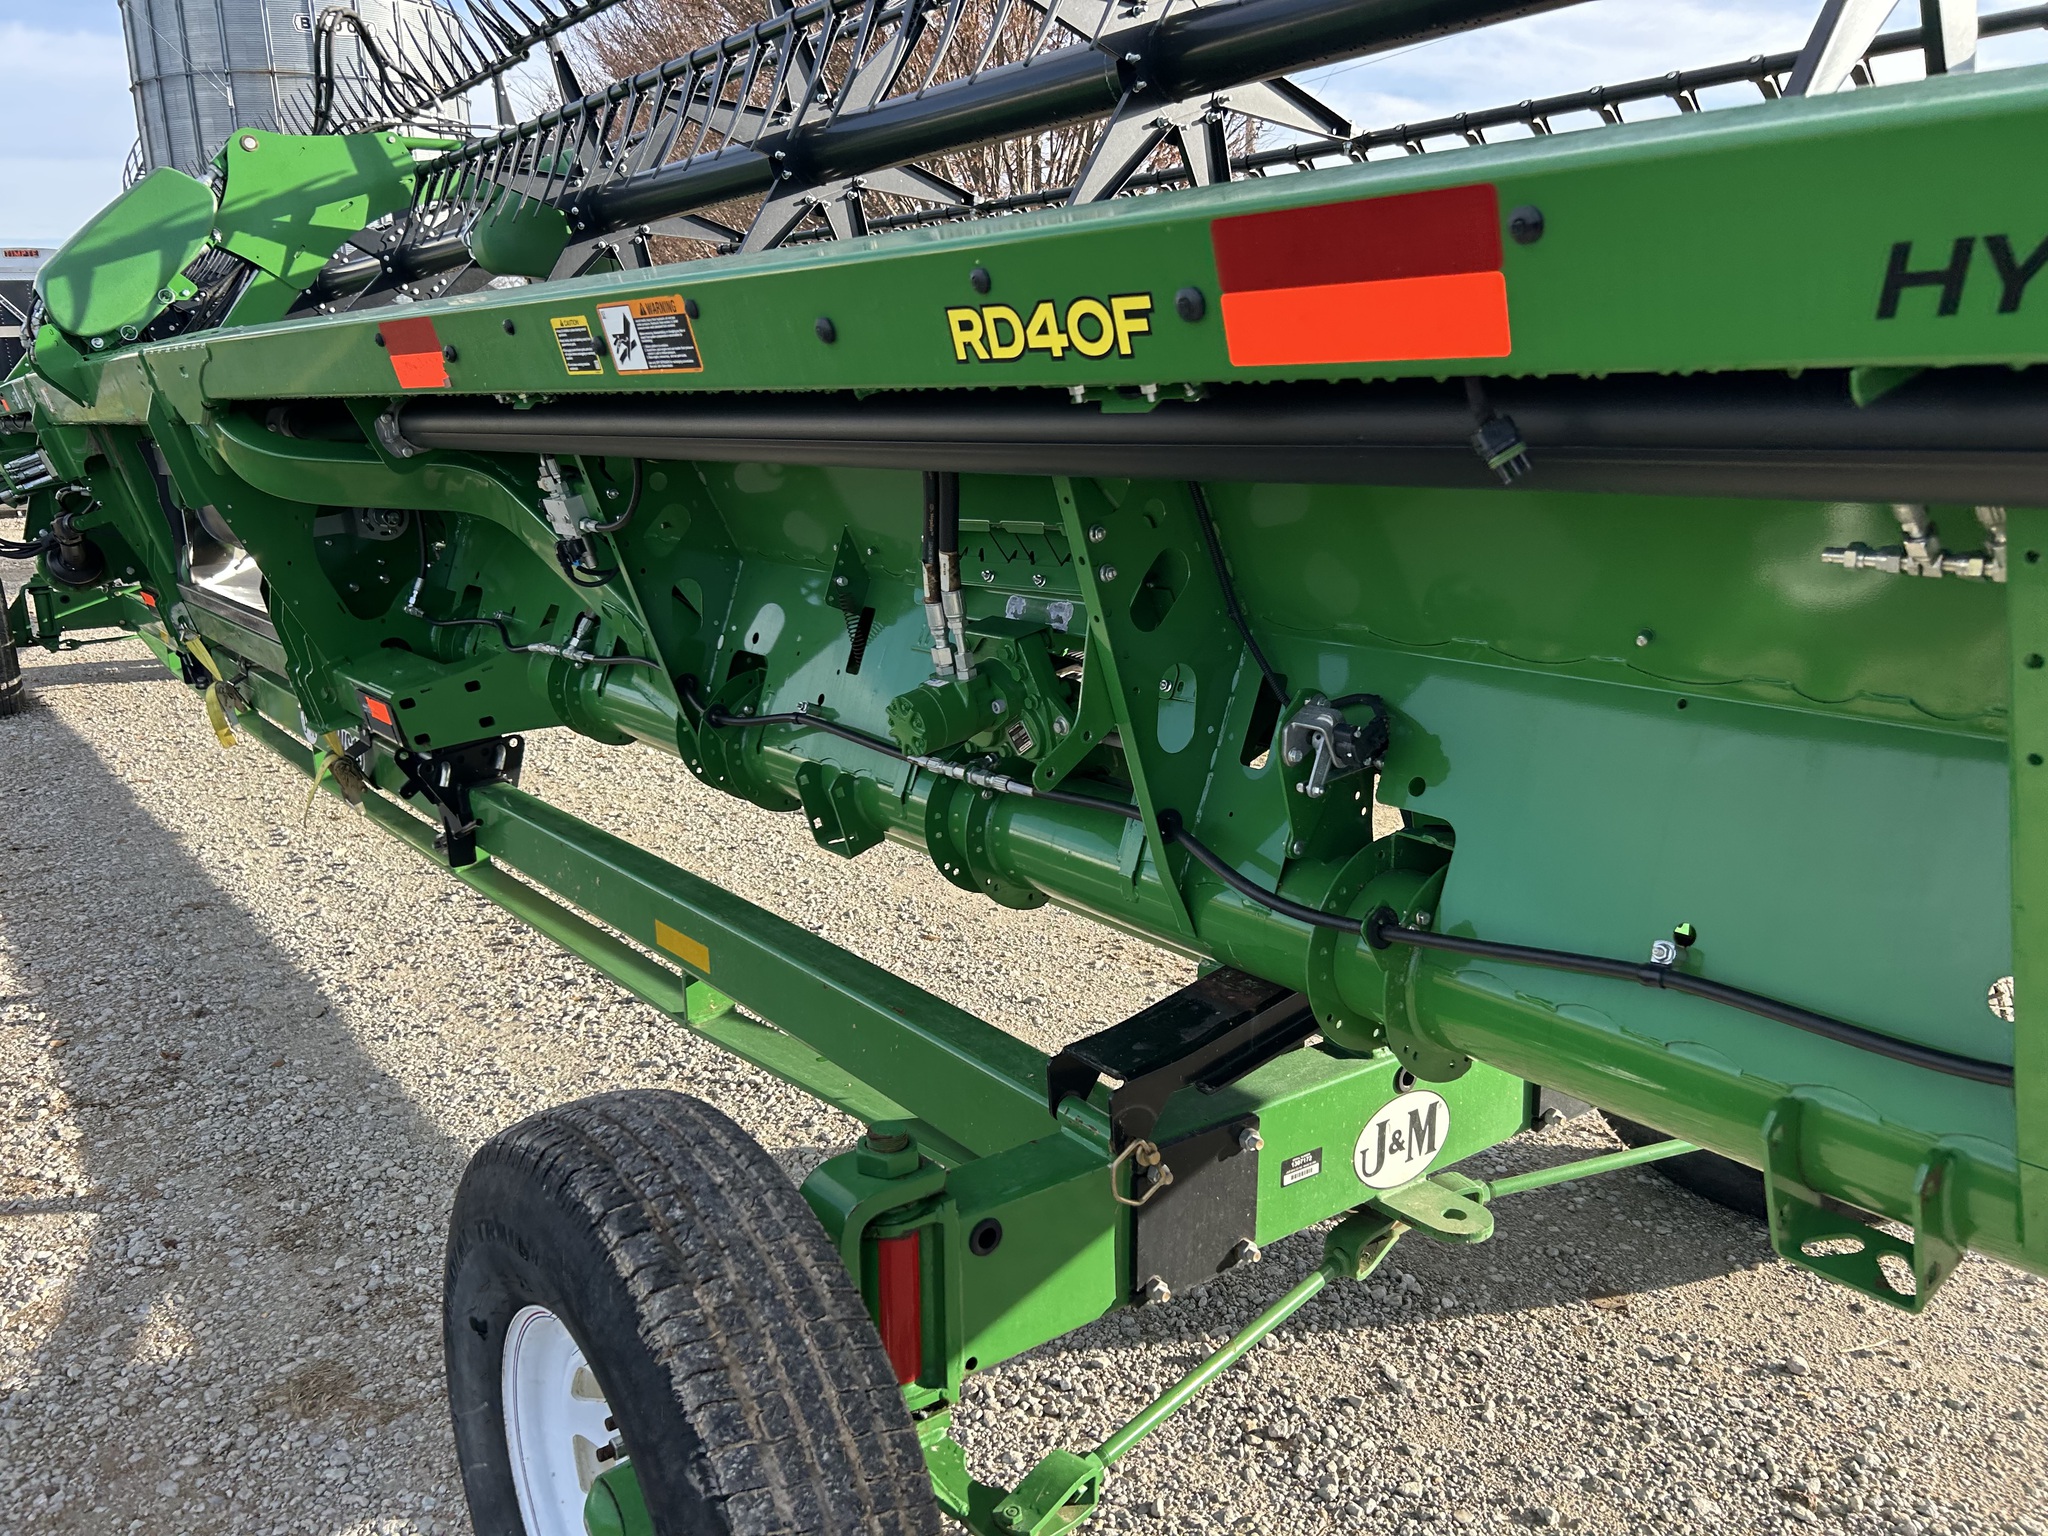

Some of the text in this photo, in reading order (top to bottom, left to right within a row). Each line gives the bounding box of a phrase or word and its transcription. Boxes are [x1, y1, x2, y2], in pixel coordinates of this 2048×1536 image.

[645, 300, 677, 316] WARNING
[1875, 234, 2048, 320] HY
[945, 292, 1154, 363] RD40F
[1360, 1101, 1439, 1177] J&M
